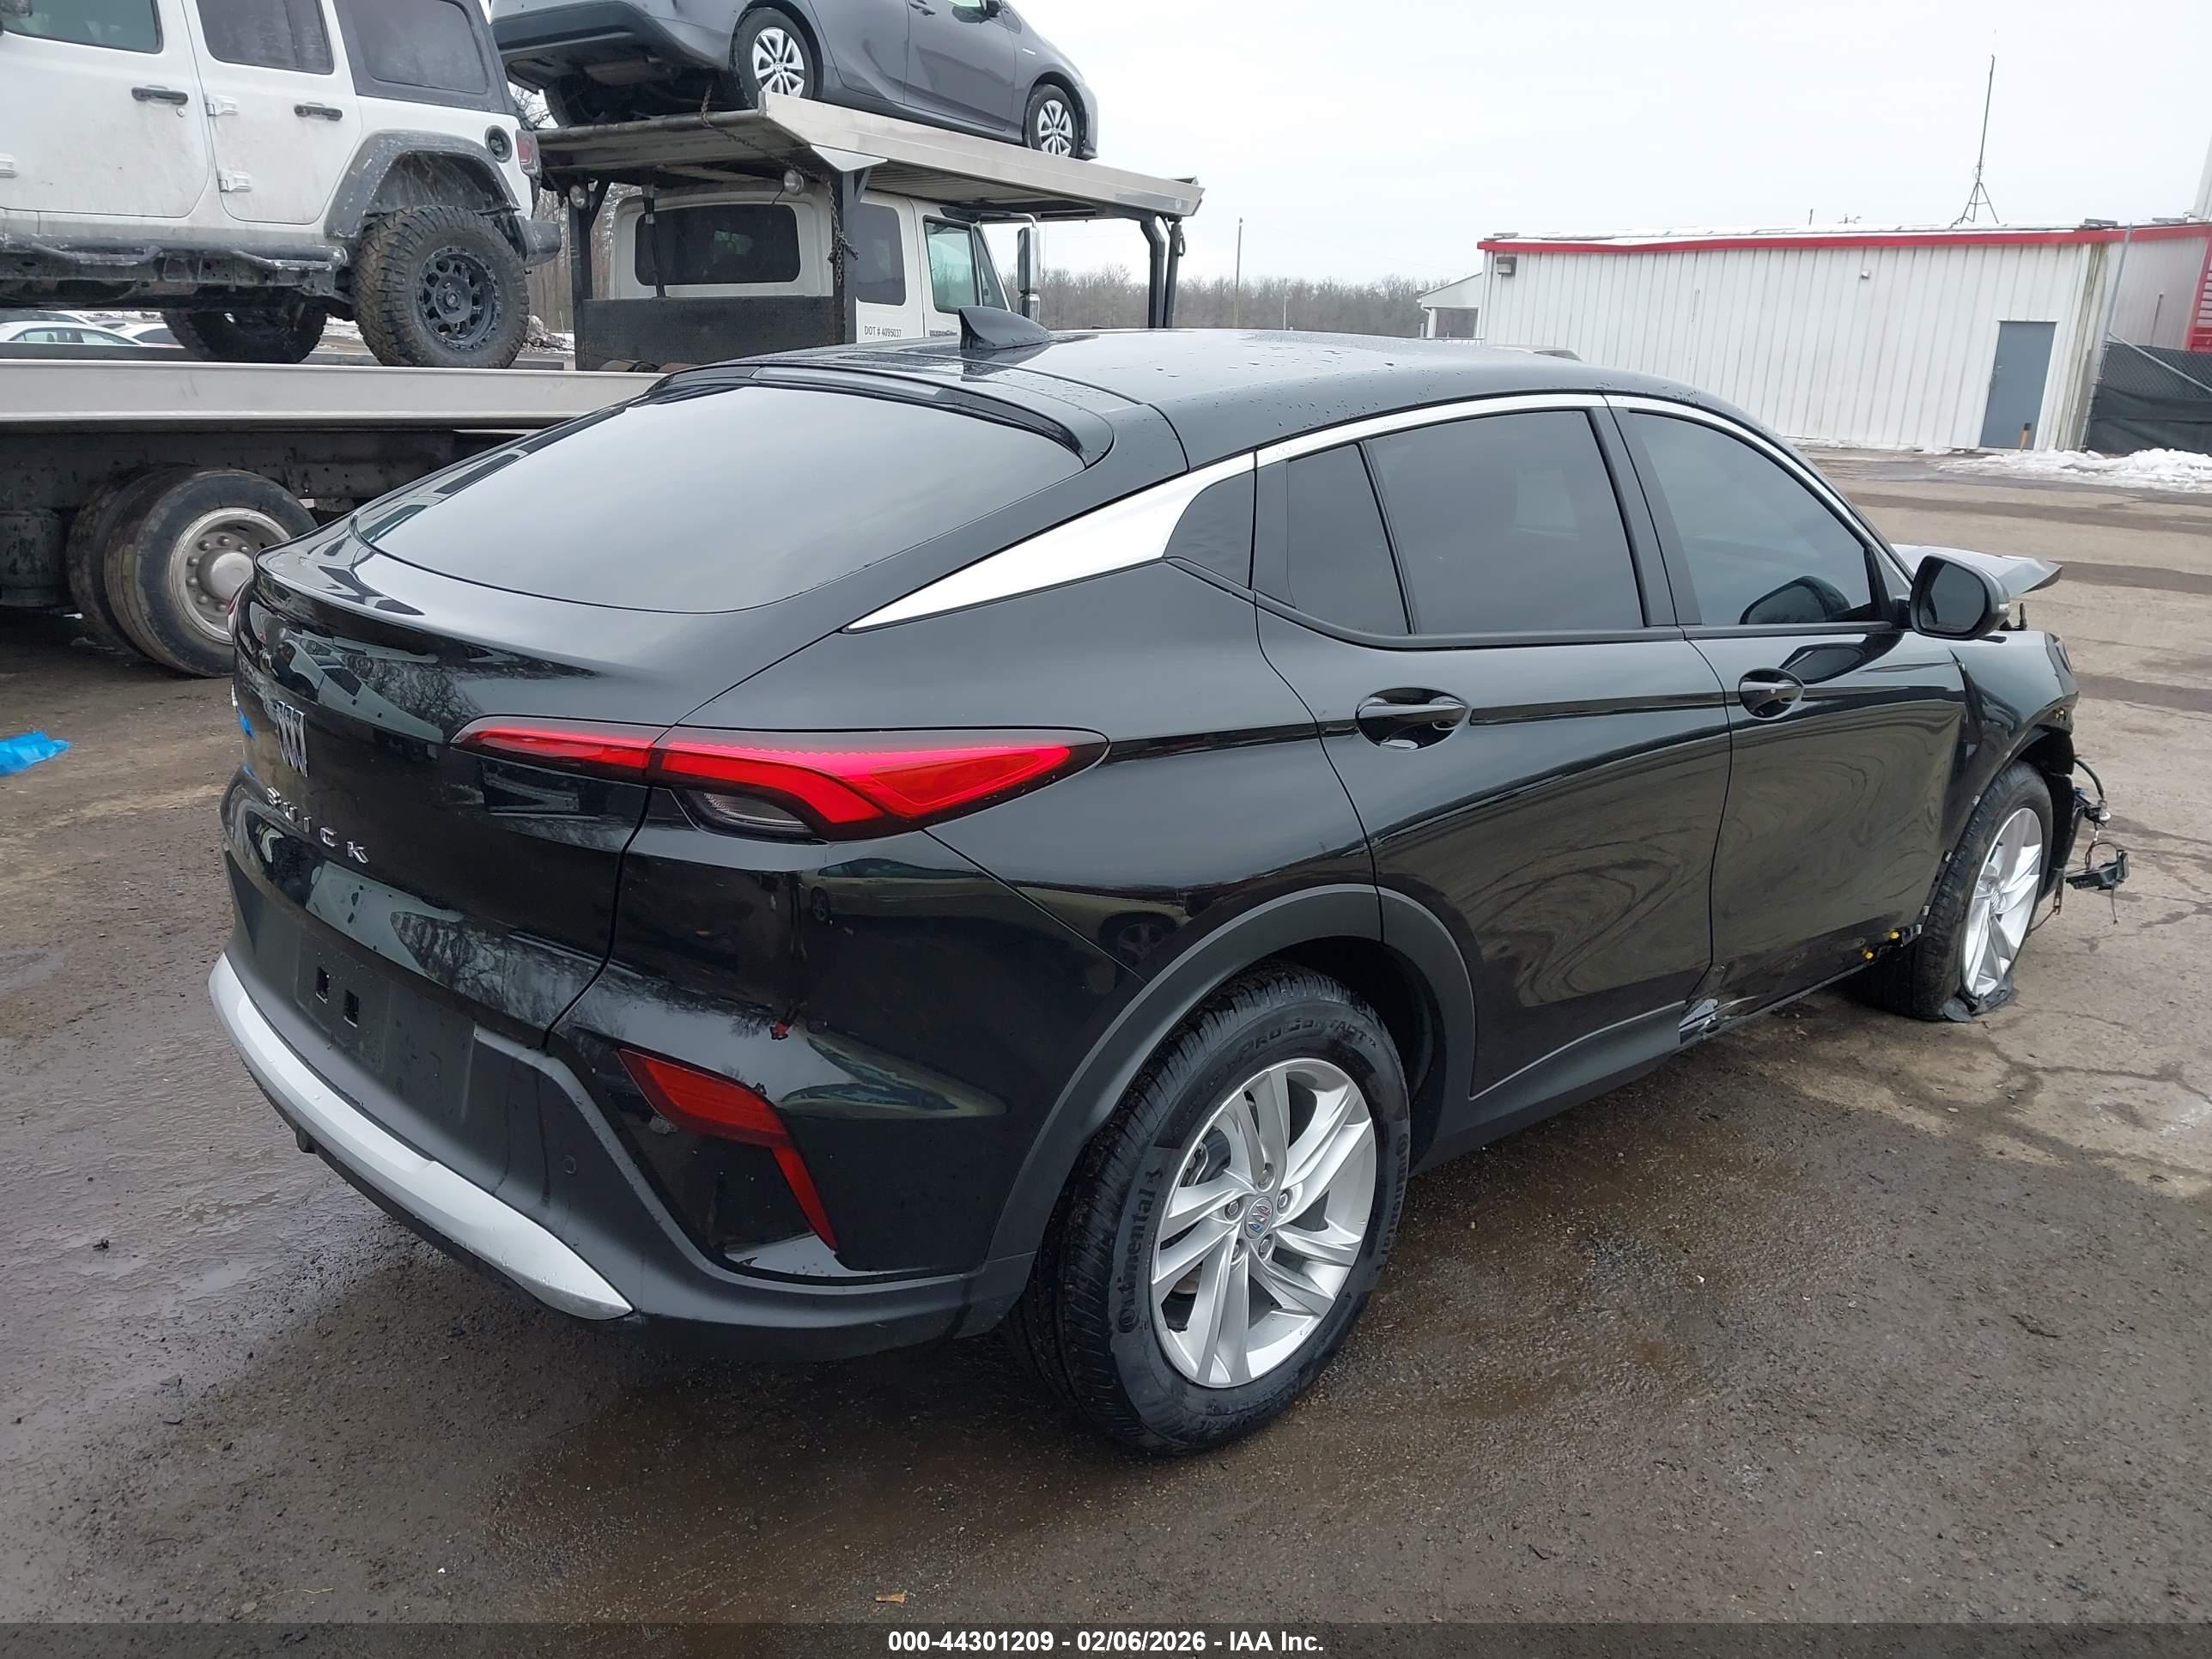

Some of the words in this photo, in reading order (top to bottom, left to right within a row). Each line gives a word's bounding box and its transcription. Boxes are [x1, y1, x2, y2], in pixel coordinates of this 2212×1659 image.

[864, 325, 876, 336] DOT
[267, 787, 369, 864] BUICK
[1118, 1188, 1157, 1334] Continental
